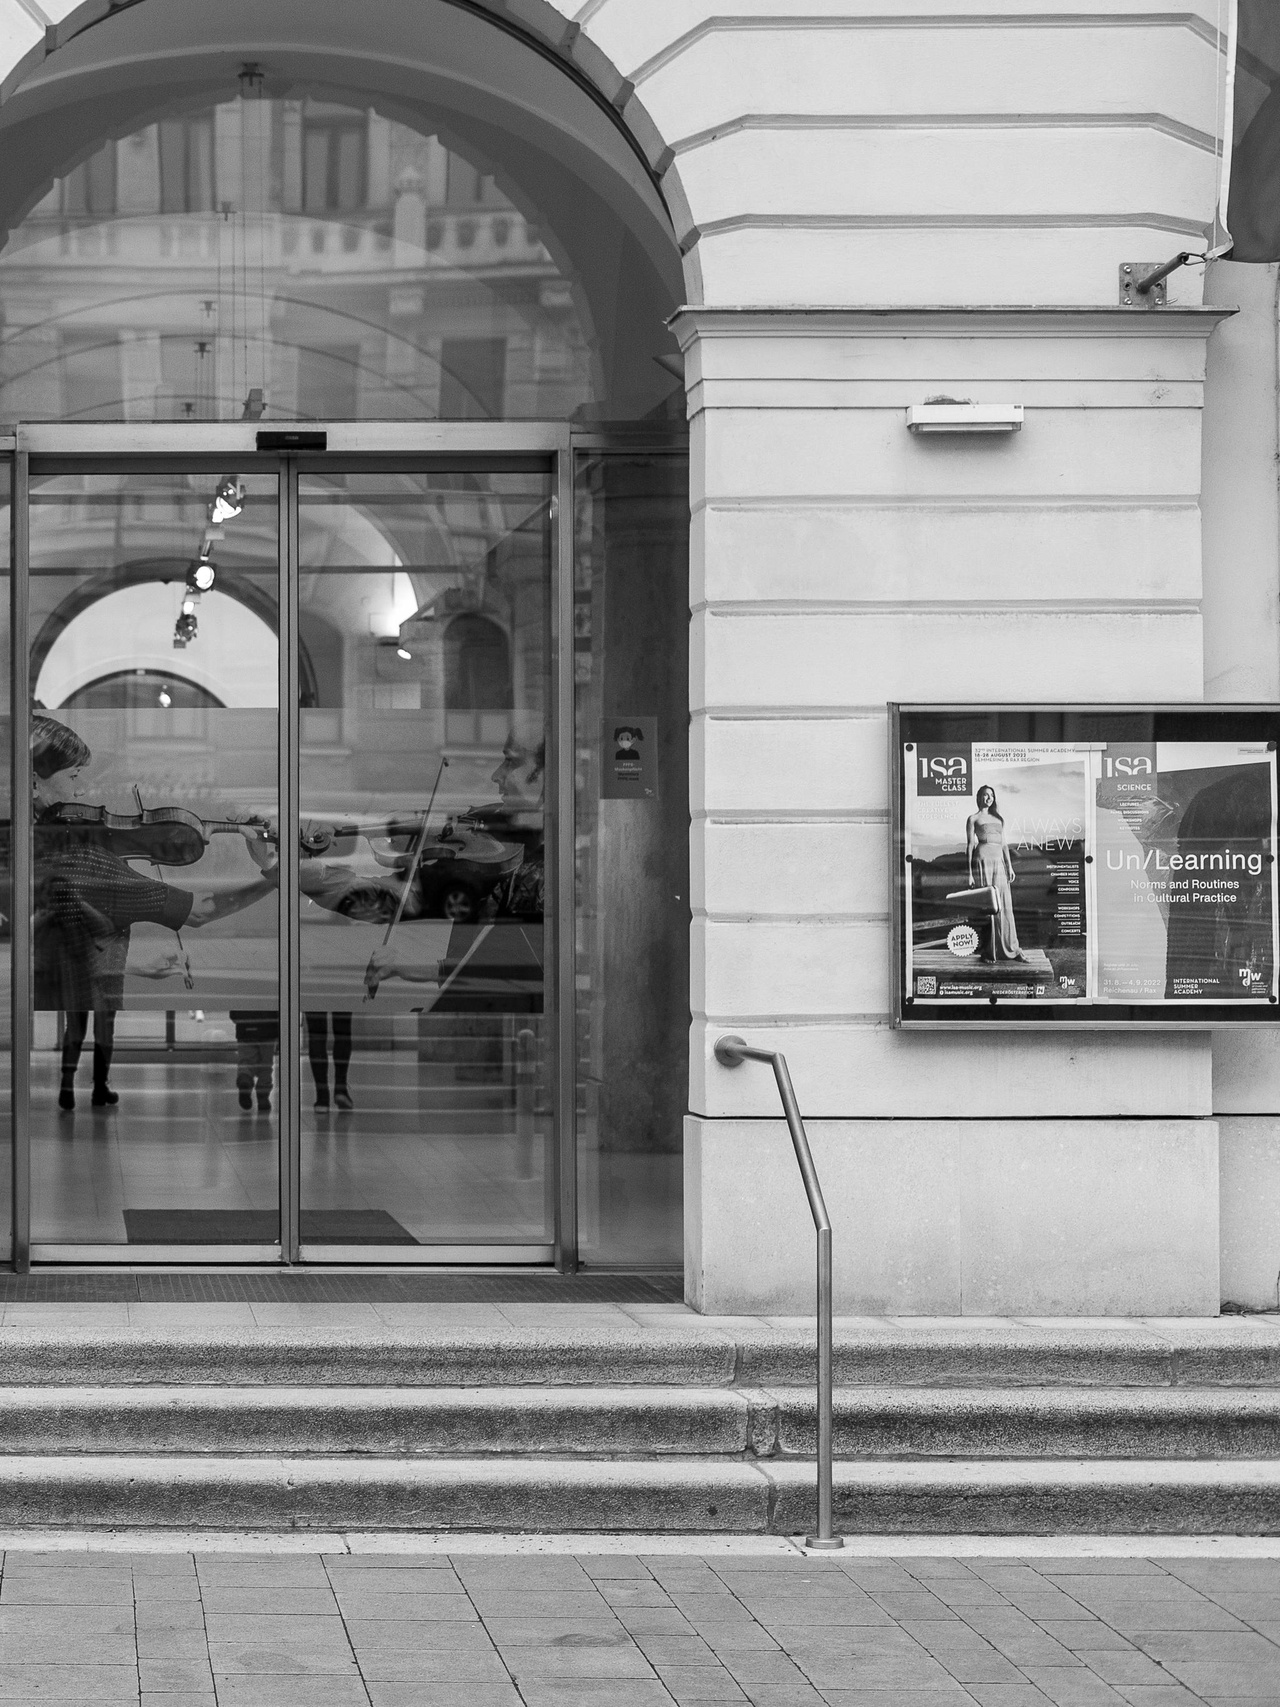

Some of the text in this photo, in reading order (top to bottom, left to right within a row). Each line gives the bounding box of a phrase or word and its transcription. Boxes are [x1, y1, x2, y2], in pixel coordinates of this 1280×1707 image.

[942, 784, 967, 792] CLASS
[1009, 817, 1082, 833] ALWAYS
[1017, 835, 1074, 851] ANEW
[1106, 849, 1262, 876] Un/Learning
[1131, 880, 1239, 889] Norms and Routines
[1133, 892, 1237, 902] in Cultural Practice
[951, 933, 973, 942] APPLY
[953, 940, 974, 948] NOW!
